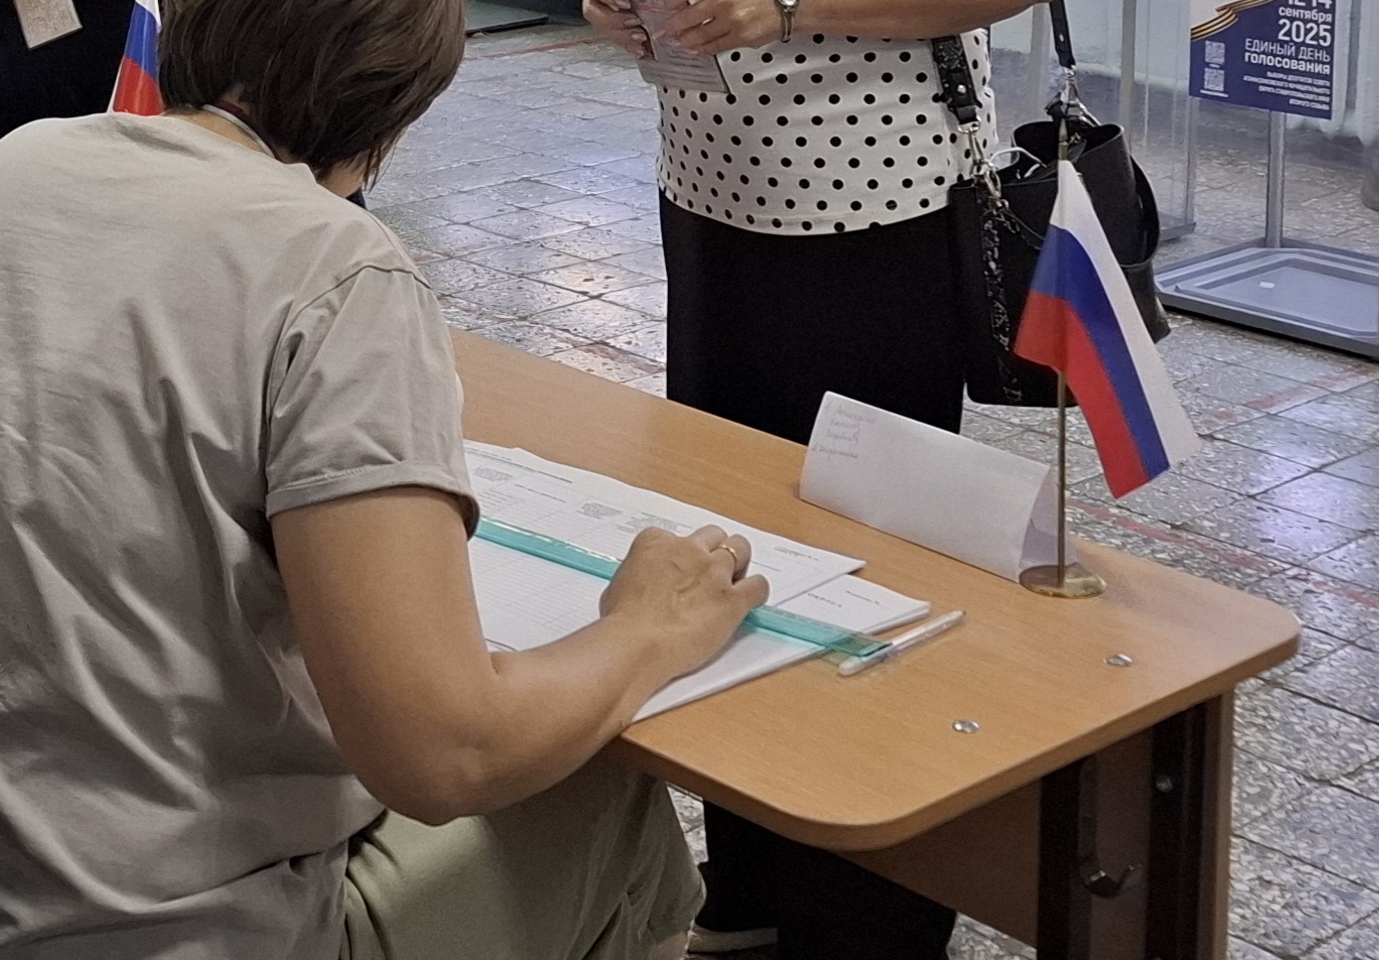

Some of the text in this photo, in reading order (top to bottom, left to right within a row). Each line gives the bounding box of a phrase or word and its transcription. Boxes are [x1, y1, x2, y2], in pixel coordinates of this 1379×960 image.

[1278, 6, 1333, 23] сентября
[1278, 19, 1332, 47] 2025
[1245, 38, 1331, 62] ЕДИНЫЙ ДЕНЬ
[1244, 52, 1332, 75] голосования
